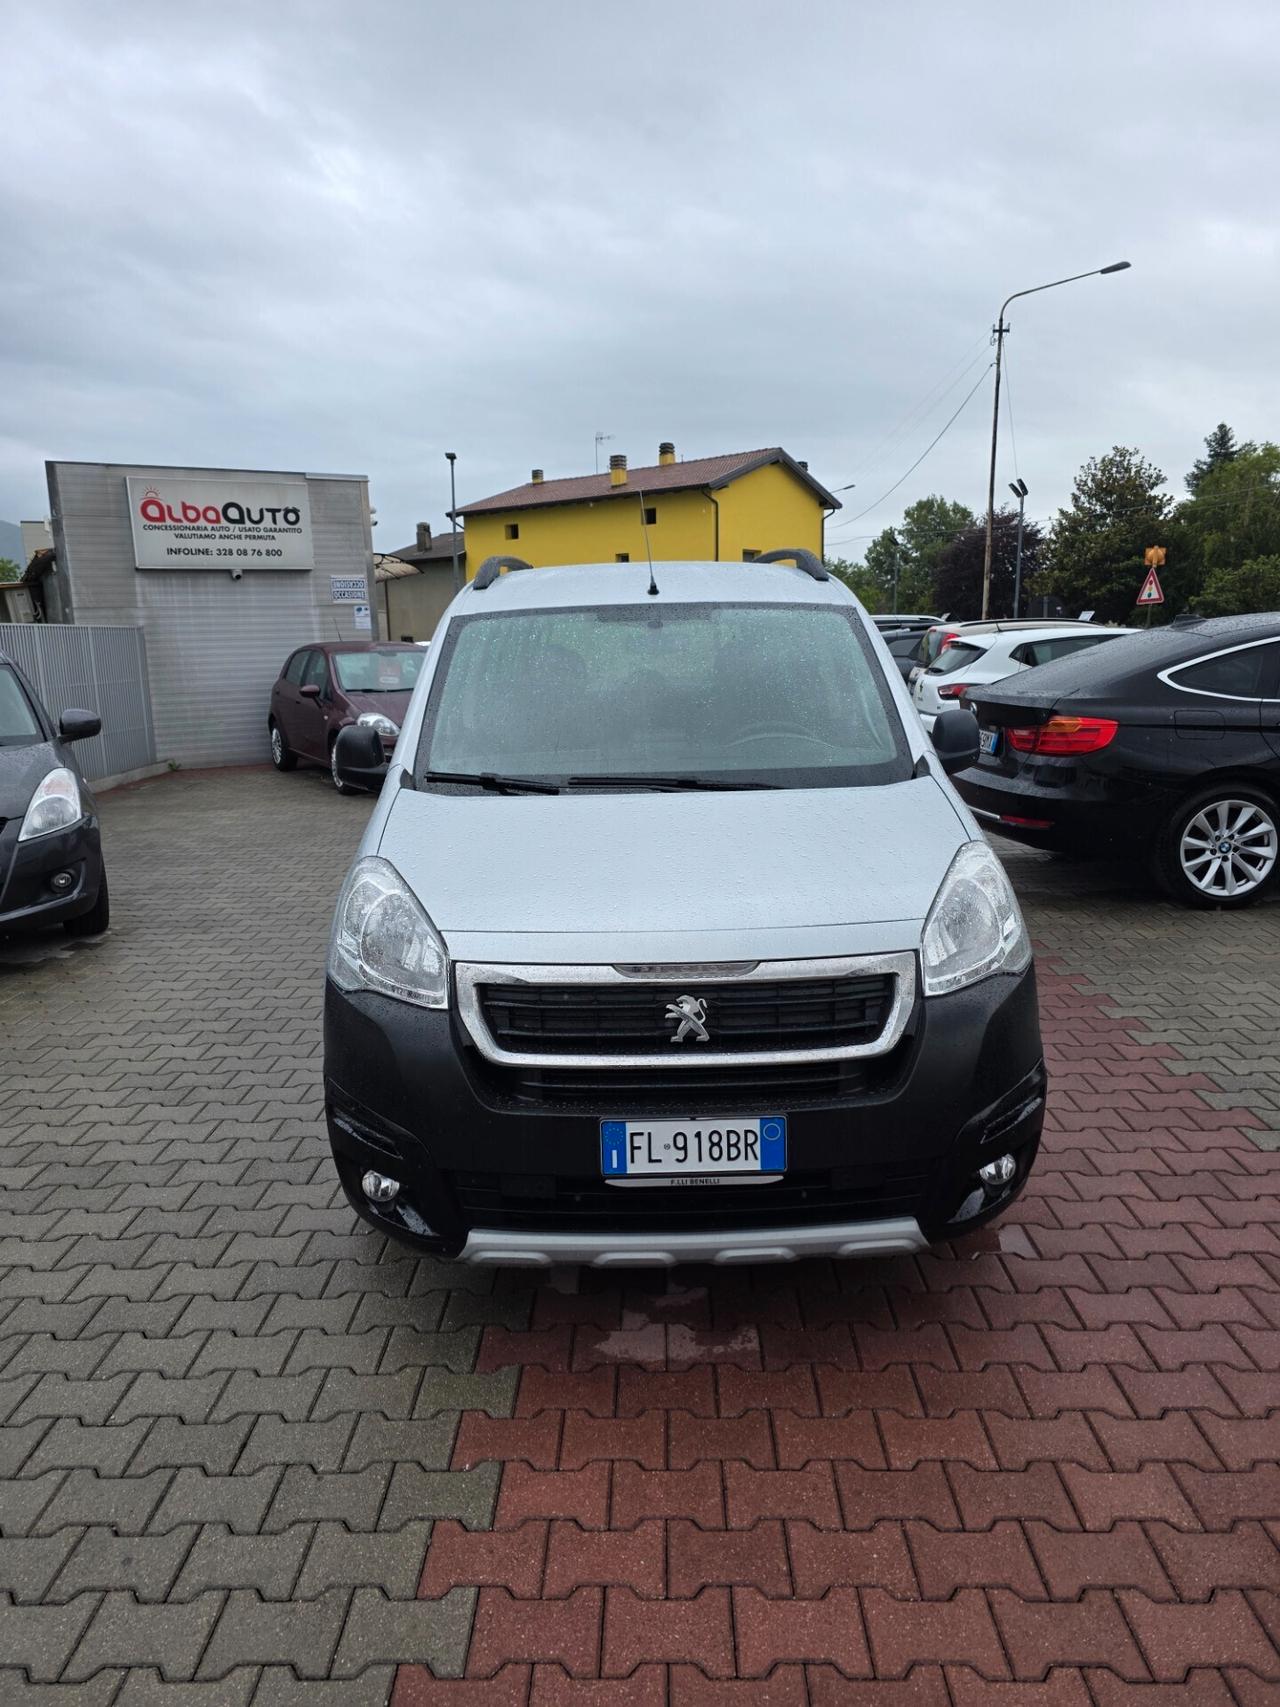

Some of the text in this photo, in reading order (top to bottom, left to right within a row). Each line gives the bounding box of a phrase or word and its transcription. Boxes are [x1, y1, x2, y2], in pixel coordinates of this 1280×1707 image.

[143, 524, 208, 532] CONCESSIONARIA
[238, 526, 262, 534] USATO
[263, 527, 303, 535] GARANTITO
[218, 533, 243, 541] ANCHE
[244, 534, 276, 542] PERMUTA
[167, 547, 283, 557] INFOLINE: 328 08 76 800
[689, 1177, 720, 1185] BENELLI
